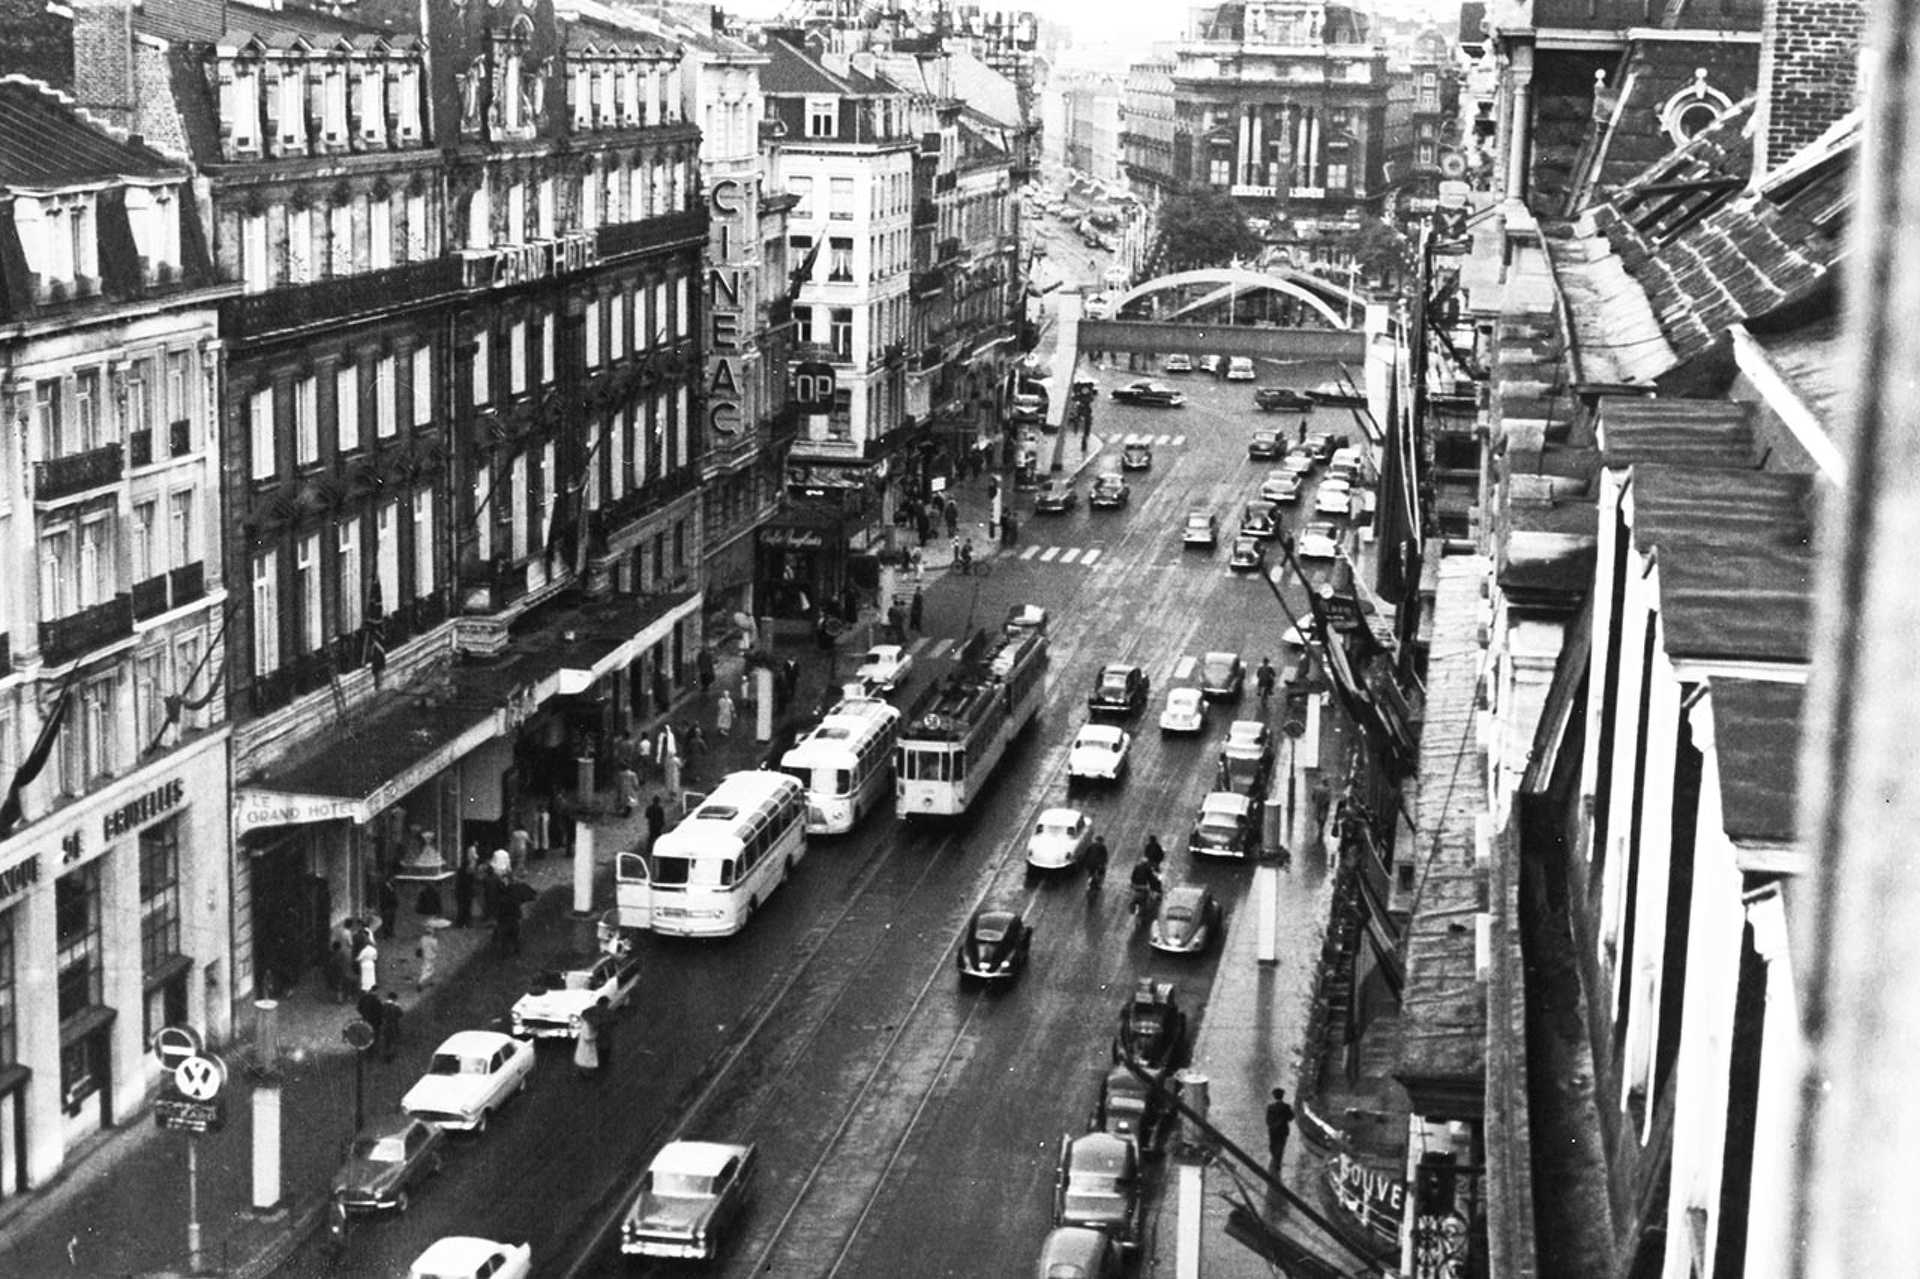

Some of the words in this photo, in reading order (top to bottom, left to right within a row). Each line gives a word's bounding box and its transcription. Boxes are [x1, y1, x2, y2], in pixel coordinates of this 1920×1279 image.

[709, 180, 741, 436] CINEAC
[103, 777, 185, 842] BRUXELLES
[247, 808, 301, 823] GRAND
[308, 801, 357, 817] HOTEL
[251, 794, 271, 808] LE
